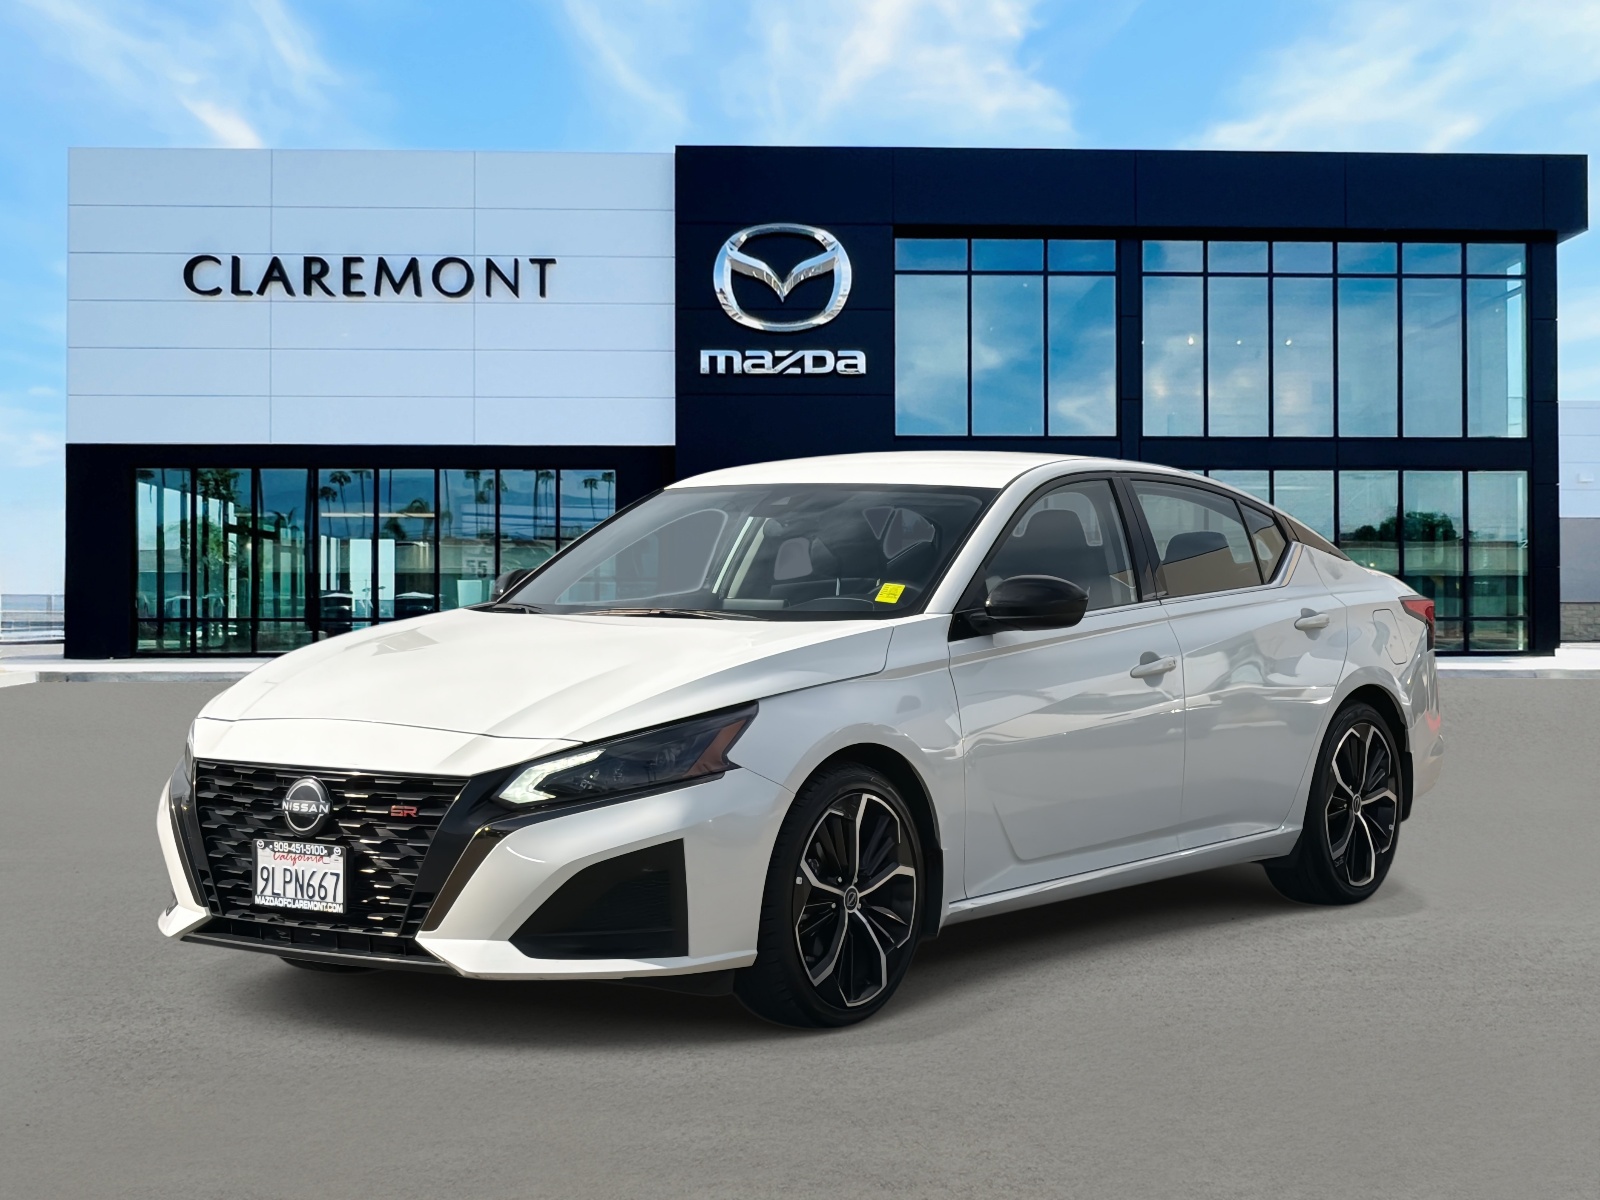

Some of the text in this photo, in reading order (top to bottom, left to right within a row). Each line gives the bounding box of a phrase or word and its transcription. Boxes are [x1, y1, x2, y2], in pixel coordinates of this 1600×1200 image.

[183, 255, 557, 299] CLAREMONT
[282, 801, 329, 813] NISSAN
[390, 805, 417, 817] SR
[273, 842, 325, 855] 909-451-5100
[273, 852, 330, 866] California
[260, 865, 341, 903] 9LPN667
[255, 895, 344, 914] MAZDAOFCLAREMONT.COM
